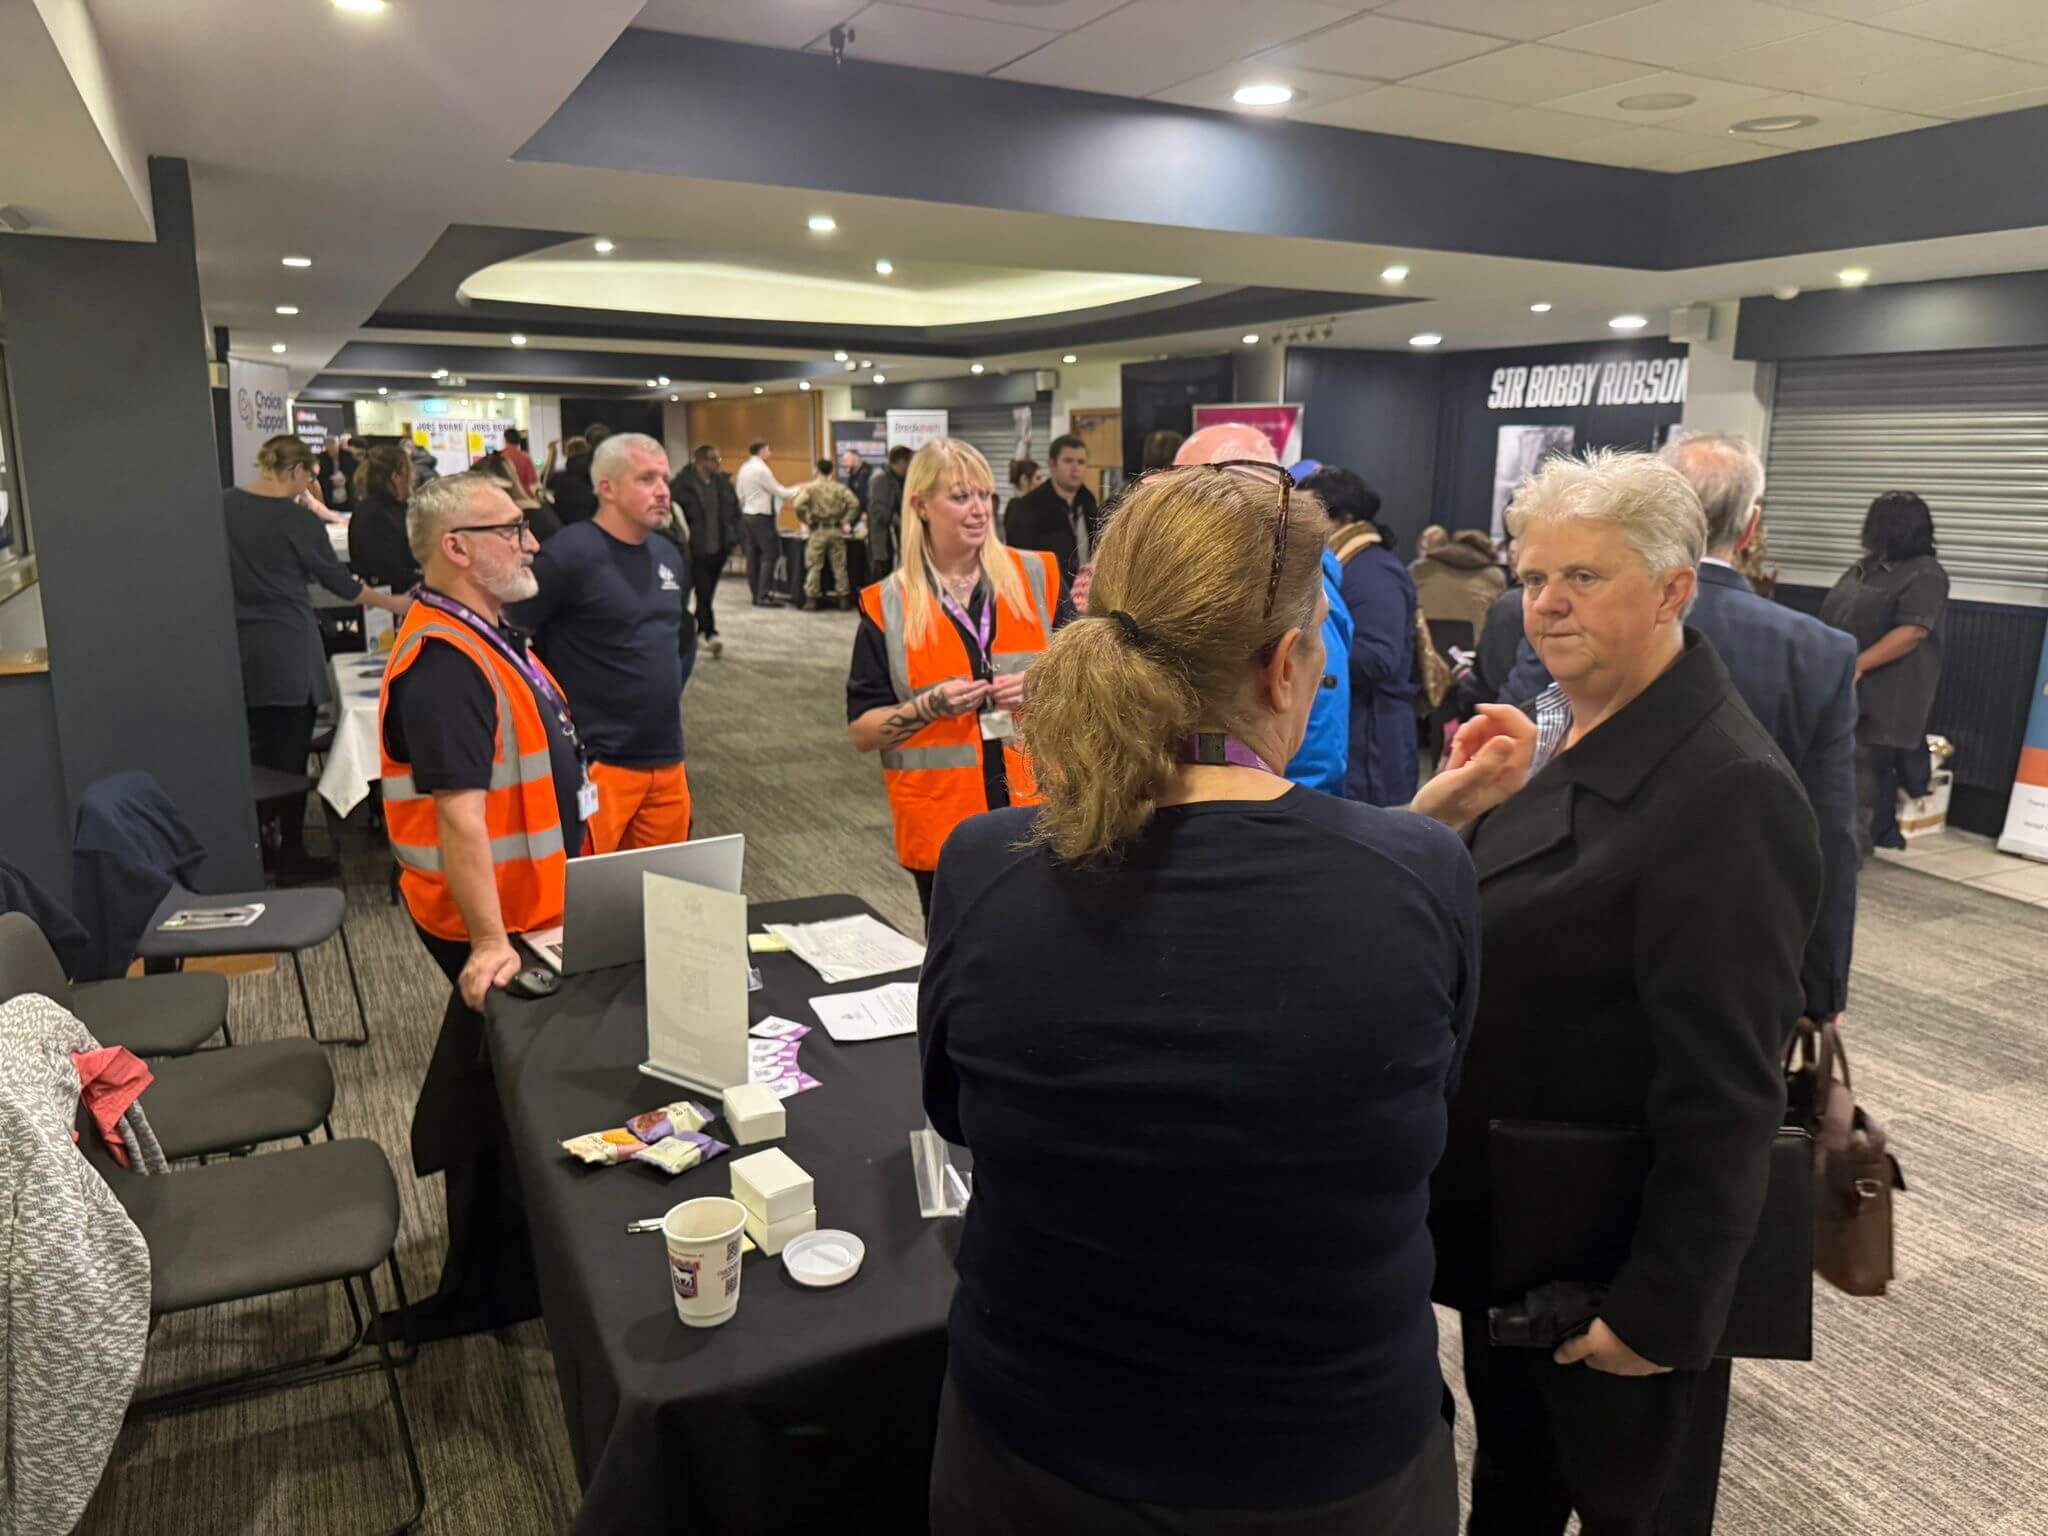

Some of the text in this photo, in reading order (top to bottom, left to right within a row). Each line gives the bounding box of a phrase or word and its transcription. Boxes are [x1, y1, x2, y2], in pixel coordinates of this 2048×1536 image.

[255, 390, 282, 409] Choice
[1487, 366, 1529, 409] SIR
[1524, 361, 1602, 408] BOBBY
